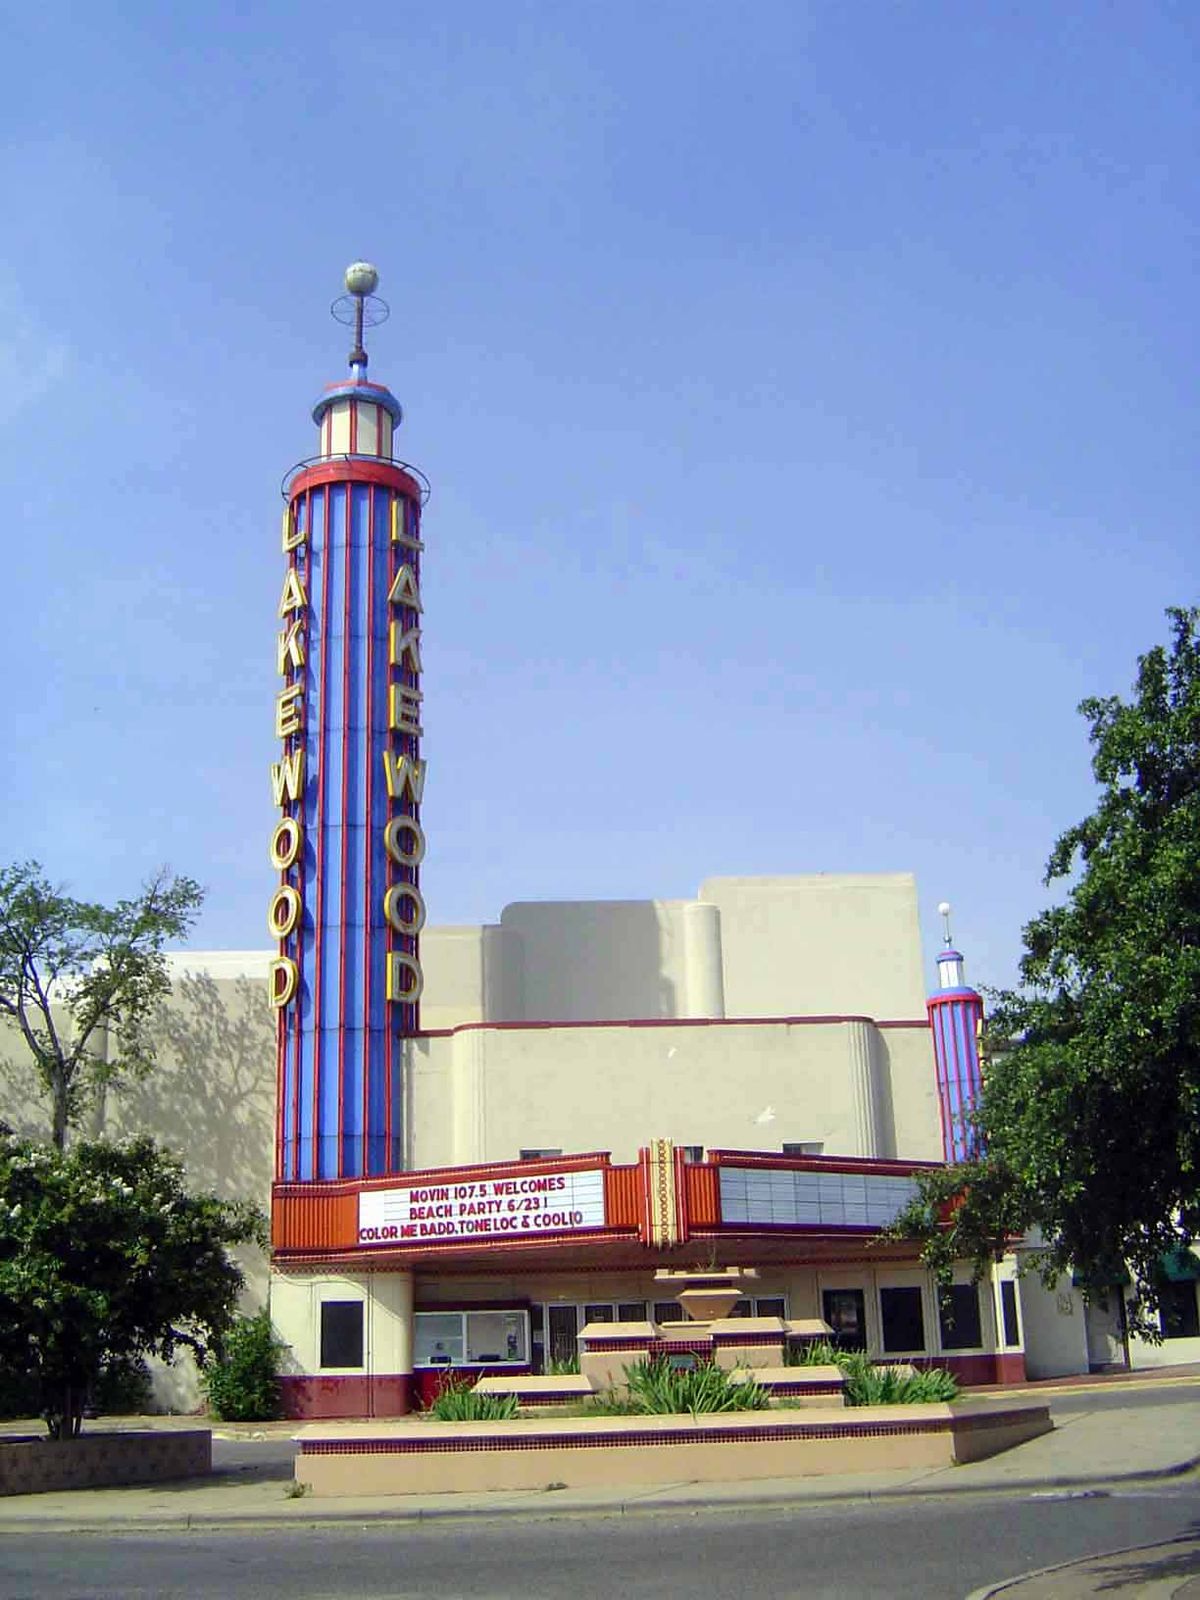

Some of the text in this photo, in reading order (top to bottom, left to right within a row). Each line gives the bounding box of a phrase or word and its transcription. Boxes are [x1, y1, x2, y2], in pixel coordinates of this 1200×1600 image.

[269, 508, 307, 1007] LAKEWOOD
[383, 500, 427, 1005] LAKEWOOD
[409, 1177, 565, 1204] MOVIN 107.5 WELCOMES
[409, 1204, 453, 1220] BEACH
[459, 1199, 502, 1217] PARTY
[507, 1197, 540, 1212] 6/23
[360, 1226, 398, 1241] COLOR
[401, 1224, 417, 1238] ME
[494, 1216, 518, 1231] LOC
[521, 1215, 530, 1229] &
[534, 1211, 583, 1227] COOLIO
